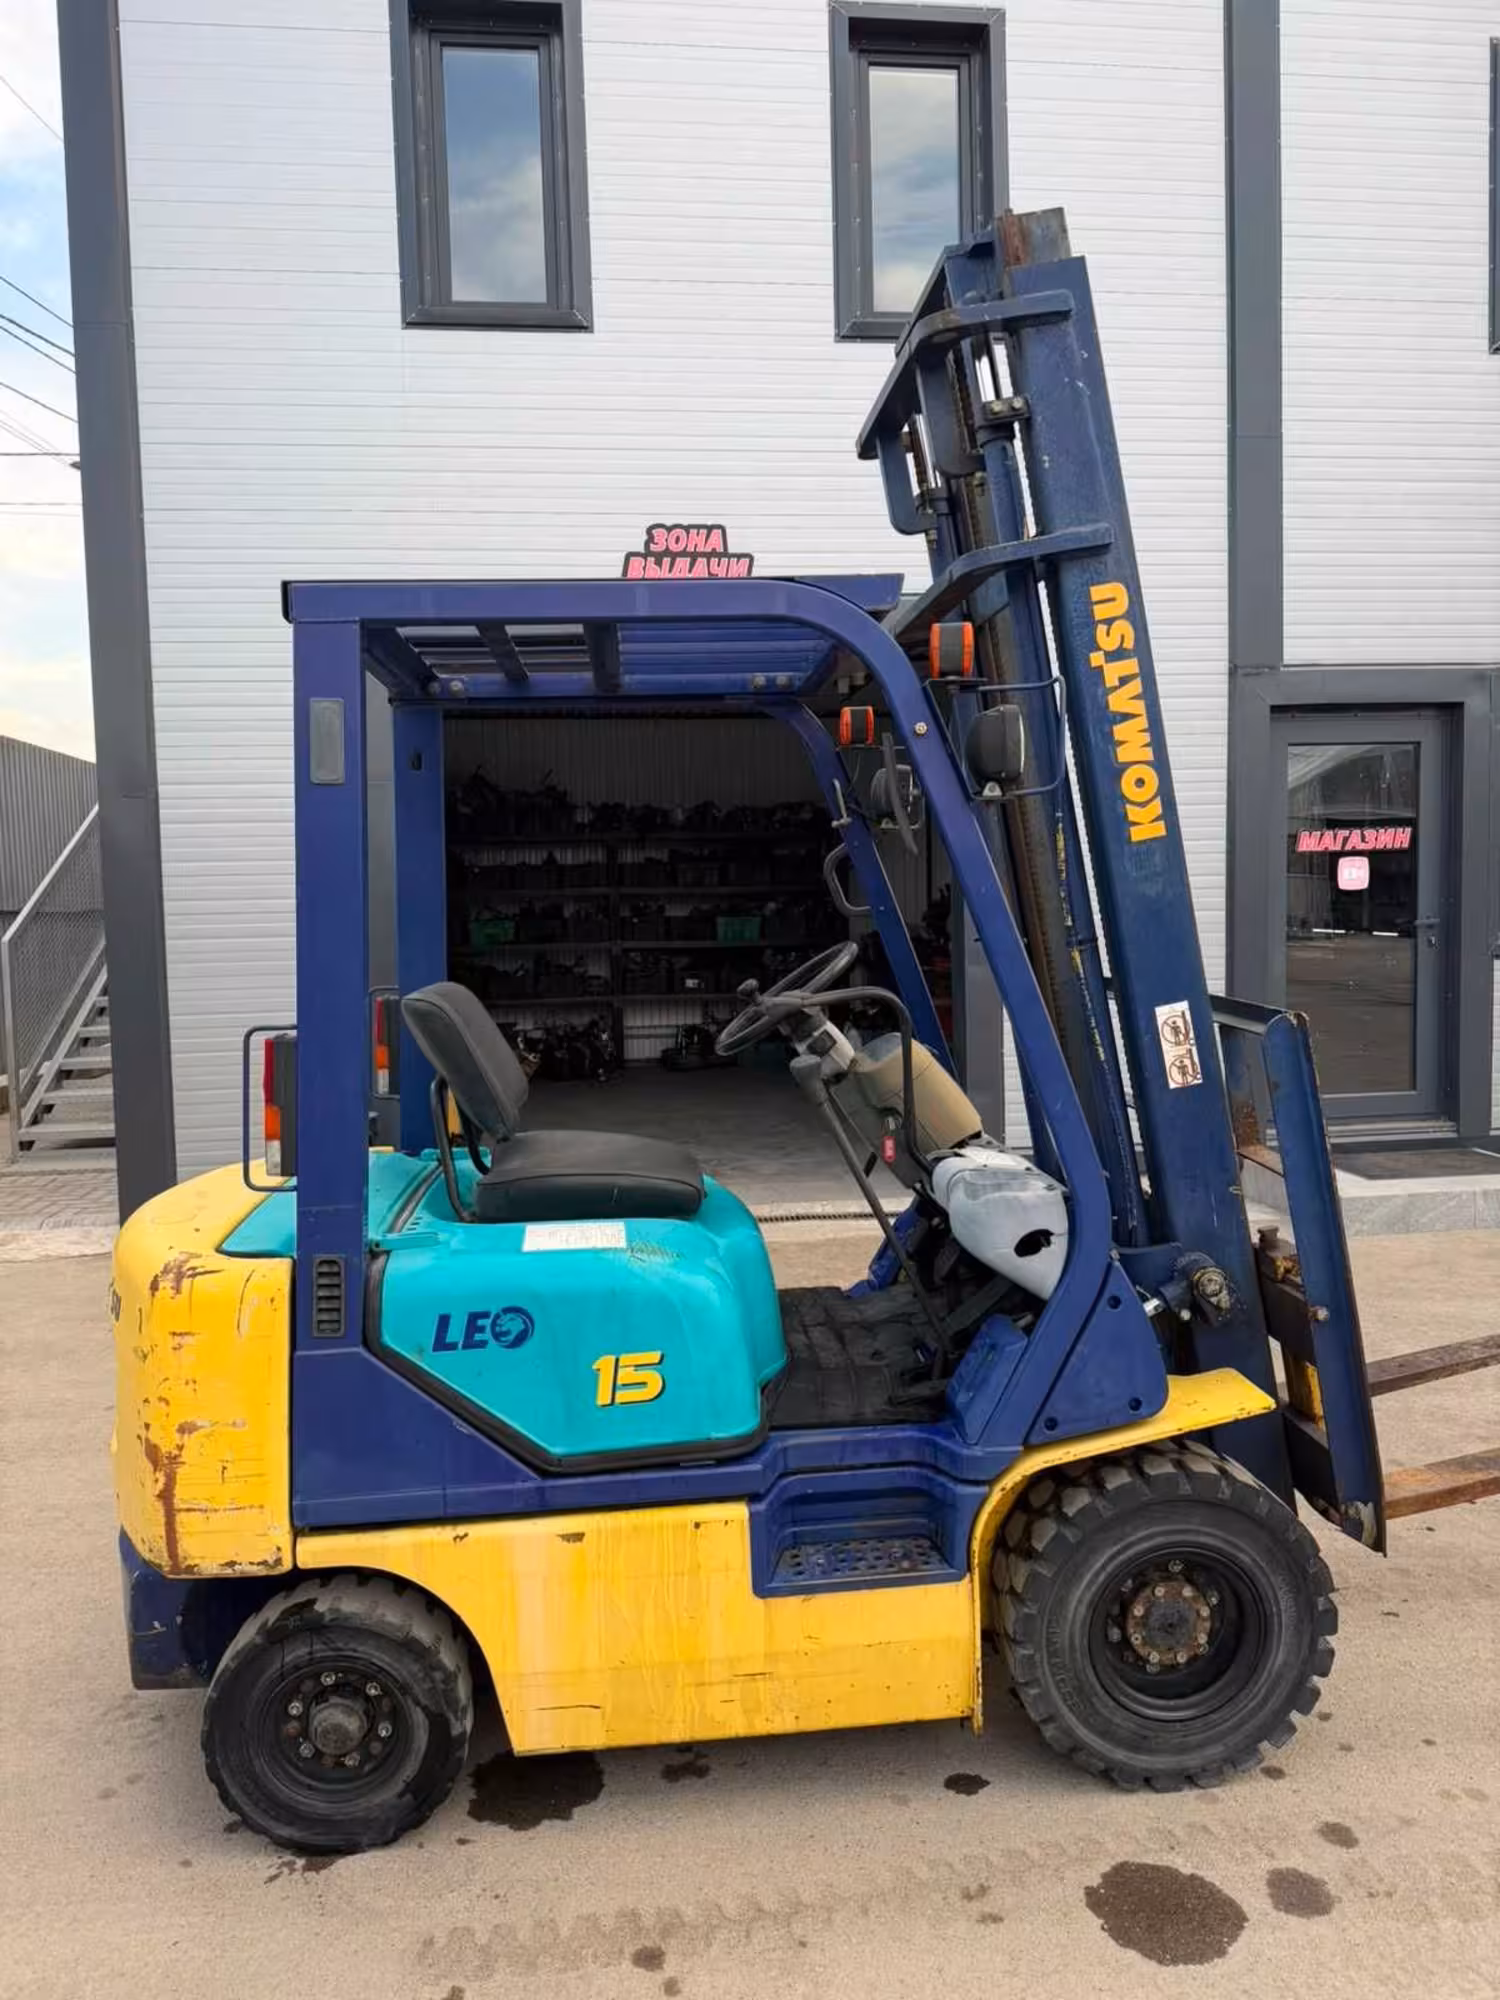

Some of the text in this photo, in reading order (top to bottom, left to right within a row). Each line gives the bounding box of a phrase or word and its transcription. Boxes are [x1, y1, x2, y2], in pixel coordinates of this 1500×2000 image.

[649, 527, 724, 553] ЗОНА
[626, 555, 750, 578] ВЫДАЧИ
[1089, 581, 1167, 842] KOMATSU
[1296, 825, 1412, 852] МАГАЗИН
[592, 1351, 666, 1407] 15
